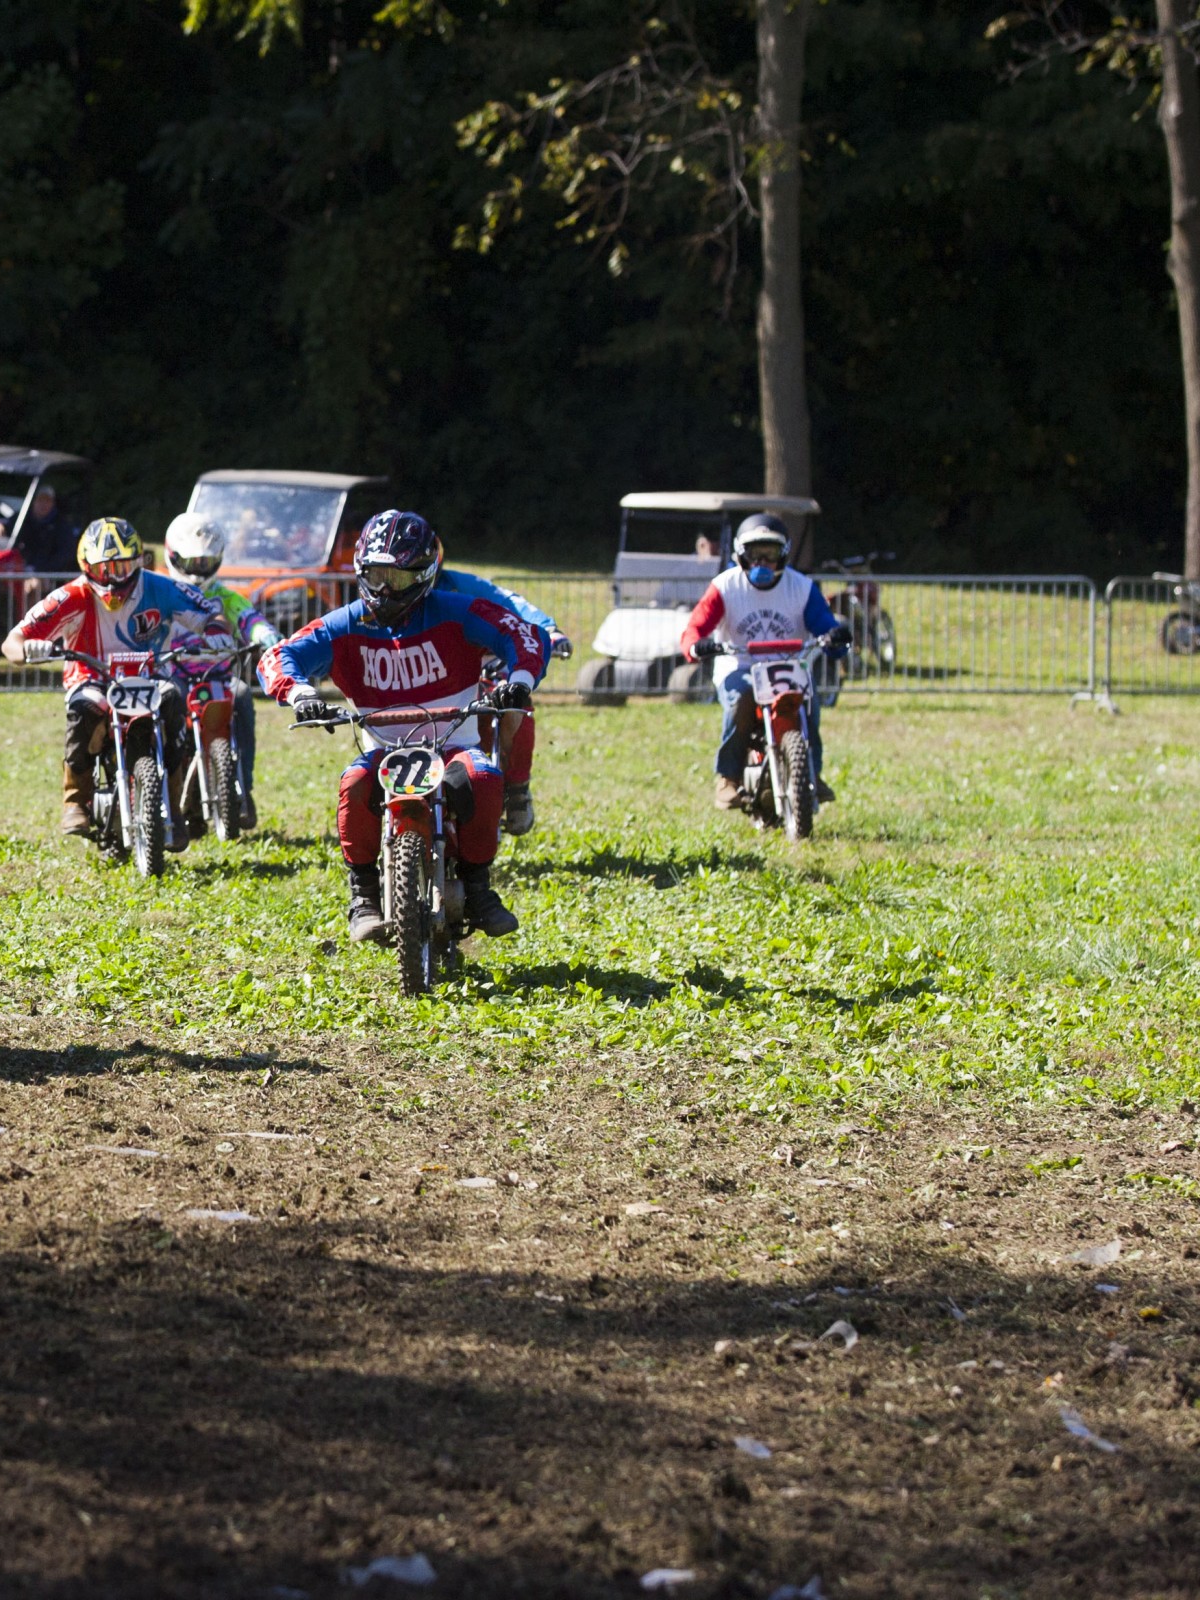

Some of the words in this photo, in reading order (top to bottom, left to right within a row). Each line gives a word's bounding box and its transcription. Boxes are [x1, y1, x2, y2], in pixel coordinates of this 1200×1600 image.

[359, 640, 448, 692] HONDA
[766, 664, 799, 696] 5
[111, 686, 155, 709] 277
[387, 750, 436, 795] 22
